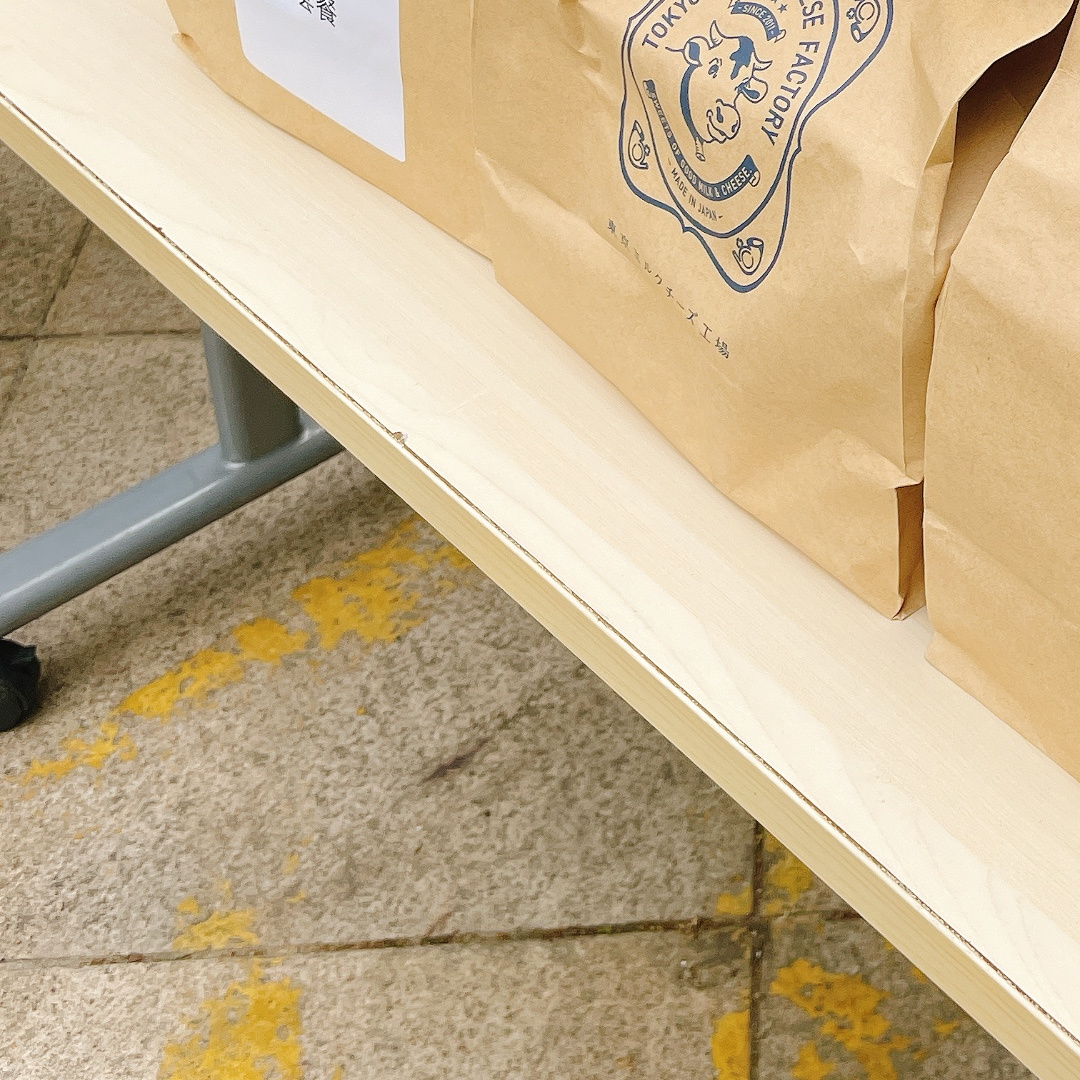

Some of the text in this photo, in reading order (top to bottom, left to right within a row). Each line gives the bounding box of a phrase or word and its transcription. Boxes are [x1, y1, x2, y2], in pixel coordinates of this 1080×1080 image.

[742, 5, 776, 31] SINCE 2011
[761, 41, 820, 146] FACTORY
[670, 142, 681, 156] OF
[680, 160, 697, 184] GOOD
[698, 182, 713, 197] MILK
[715, 187, 721, 198] &
[671, 167, 718, 221] MADE IN JAPAN
[607, 218, 730, 359] 東京ミルクチーズ工場
